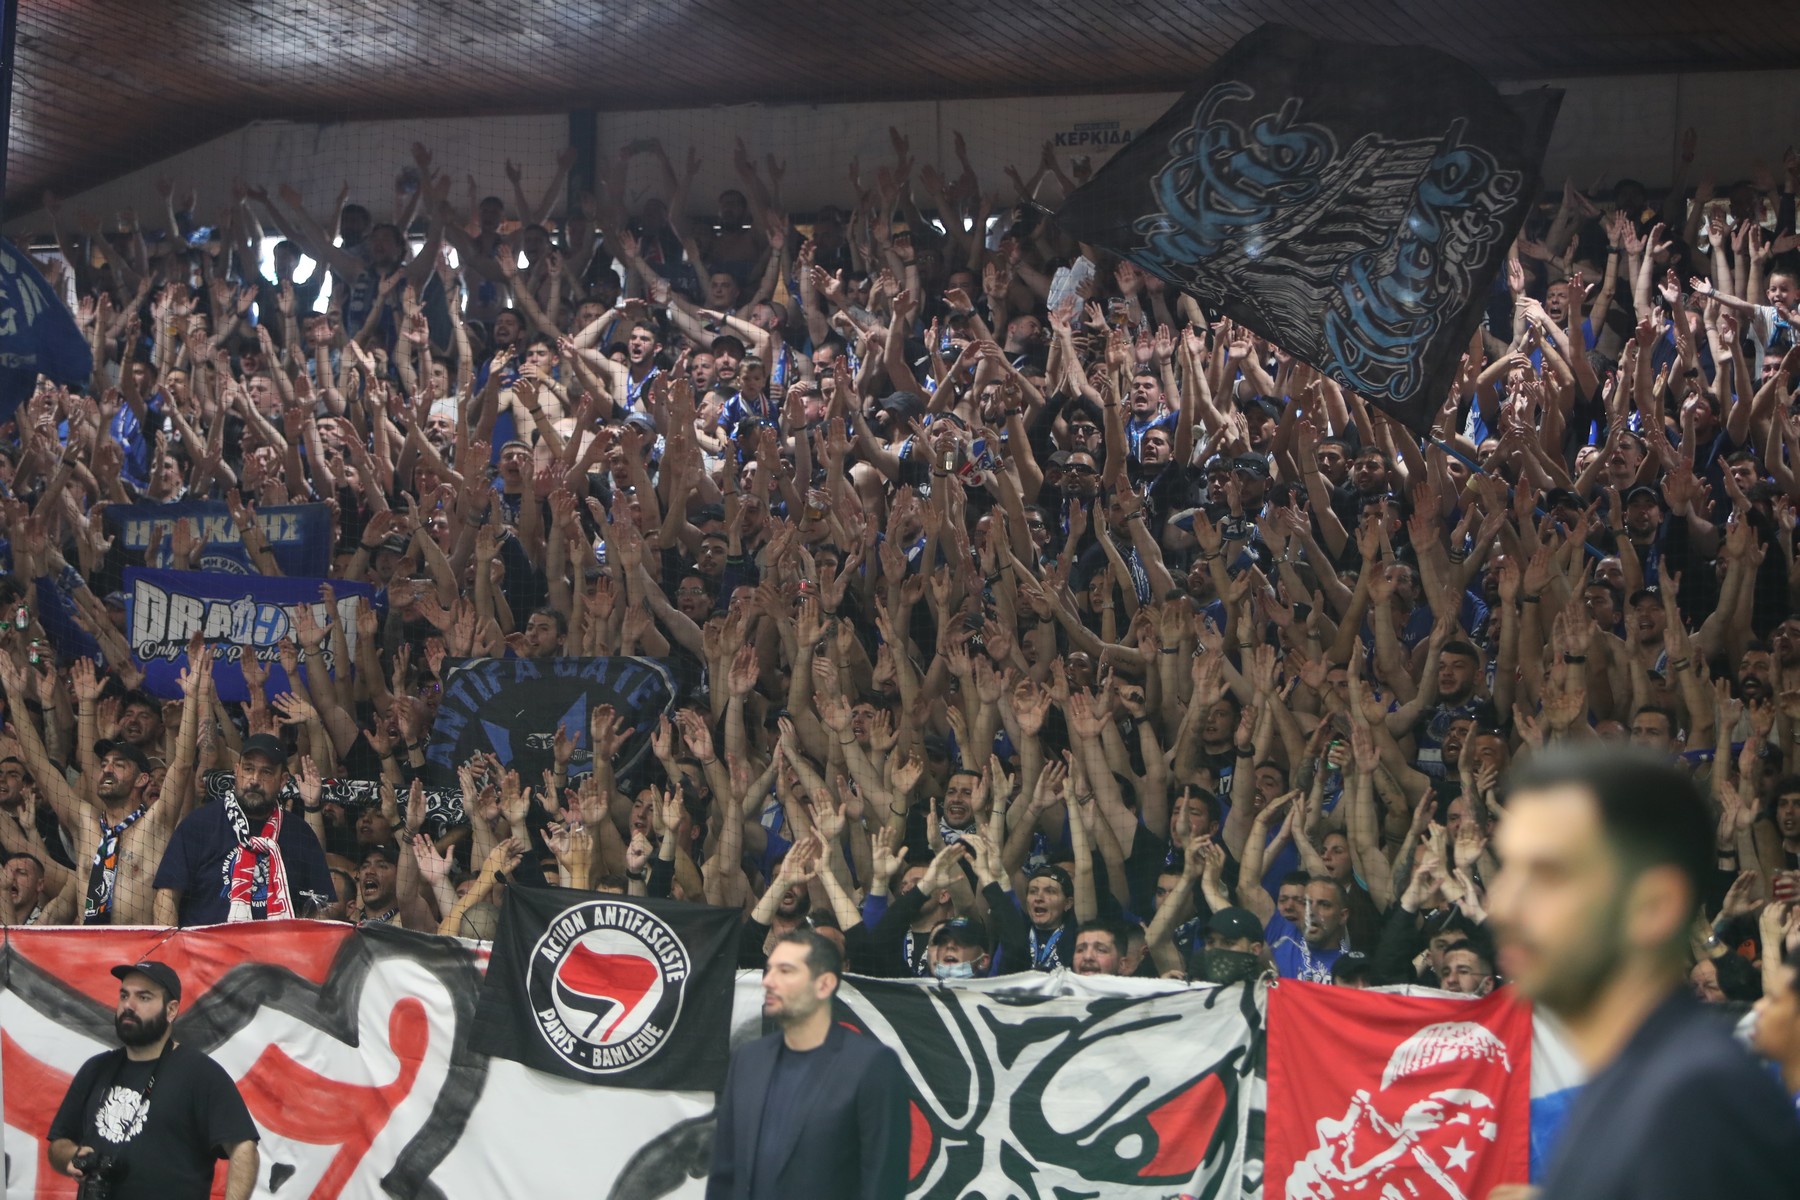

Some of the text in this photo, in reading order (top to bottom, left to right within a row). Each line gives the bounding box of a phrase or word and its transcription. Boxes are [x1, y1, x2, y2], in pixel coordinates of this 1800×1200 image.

[1055, 130, 1132, 147] ΚΕΡΚΙΔΑ
[138, 640, 182, 662] Only
[540, 905, 685, 983] ACTION ANTIFASCISTE
[538, 1007, 578, 1055] PARIS
[592, 1021, 665, 1068] BANLIEUE
